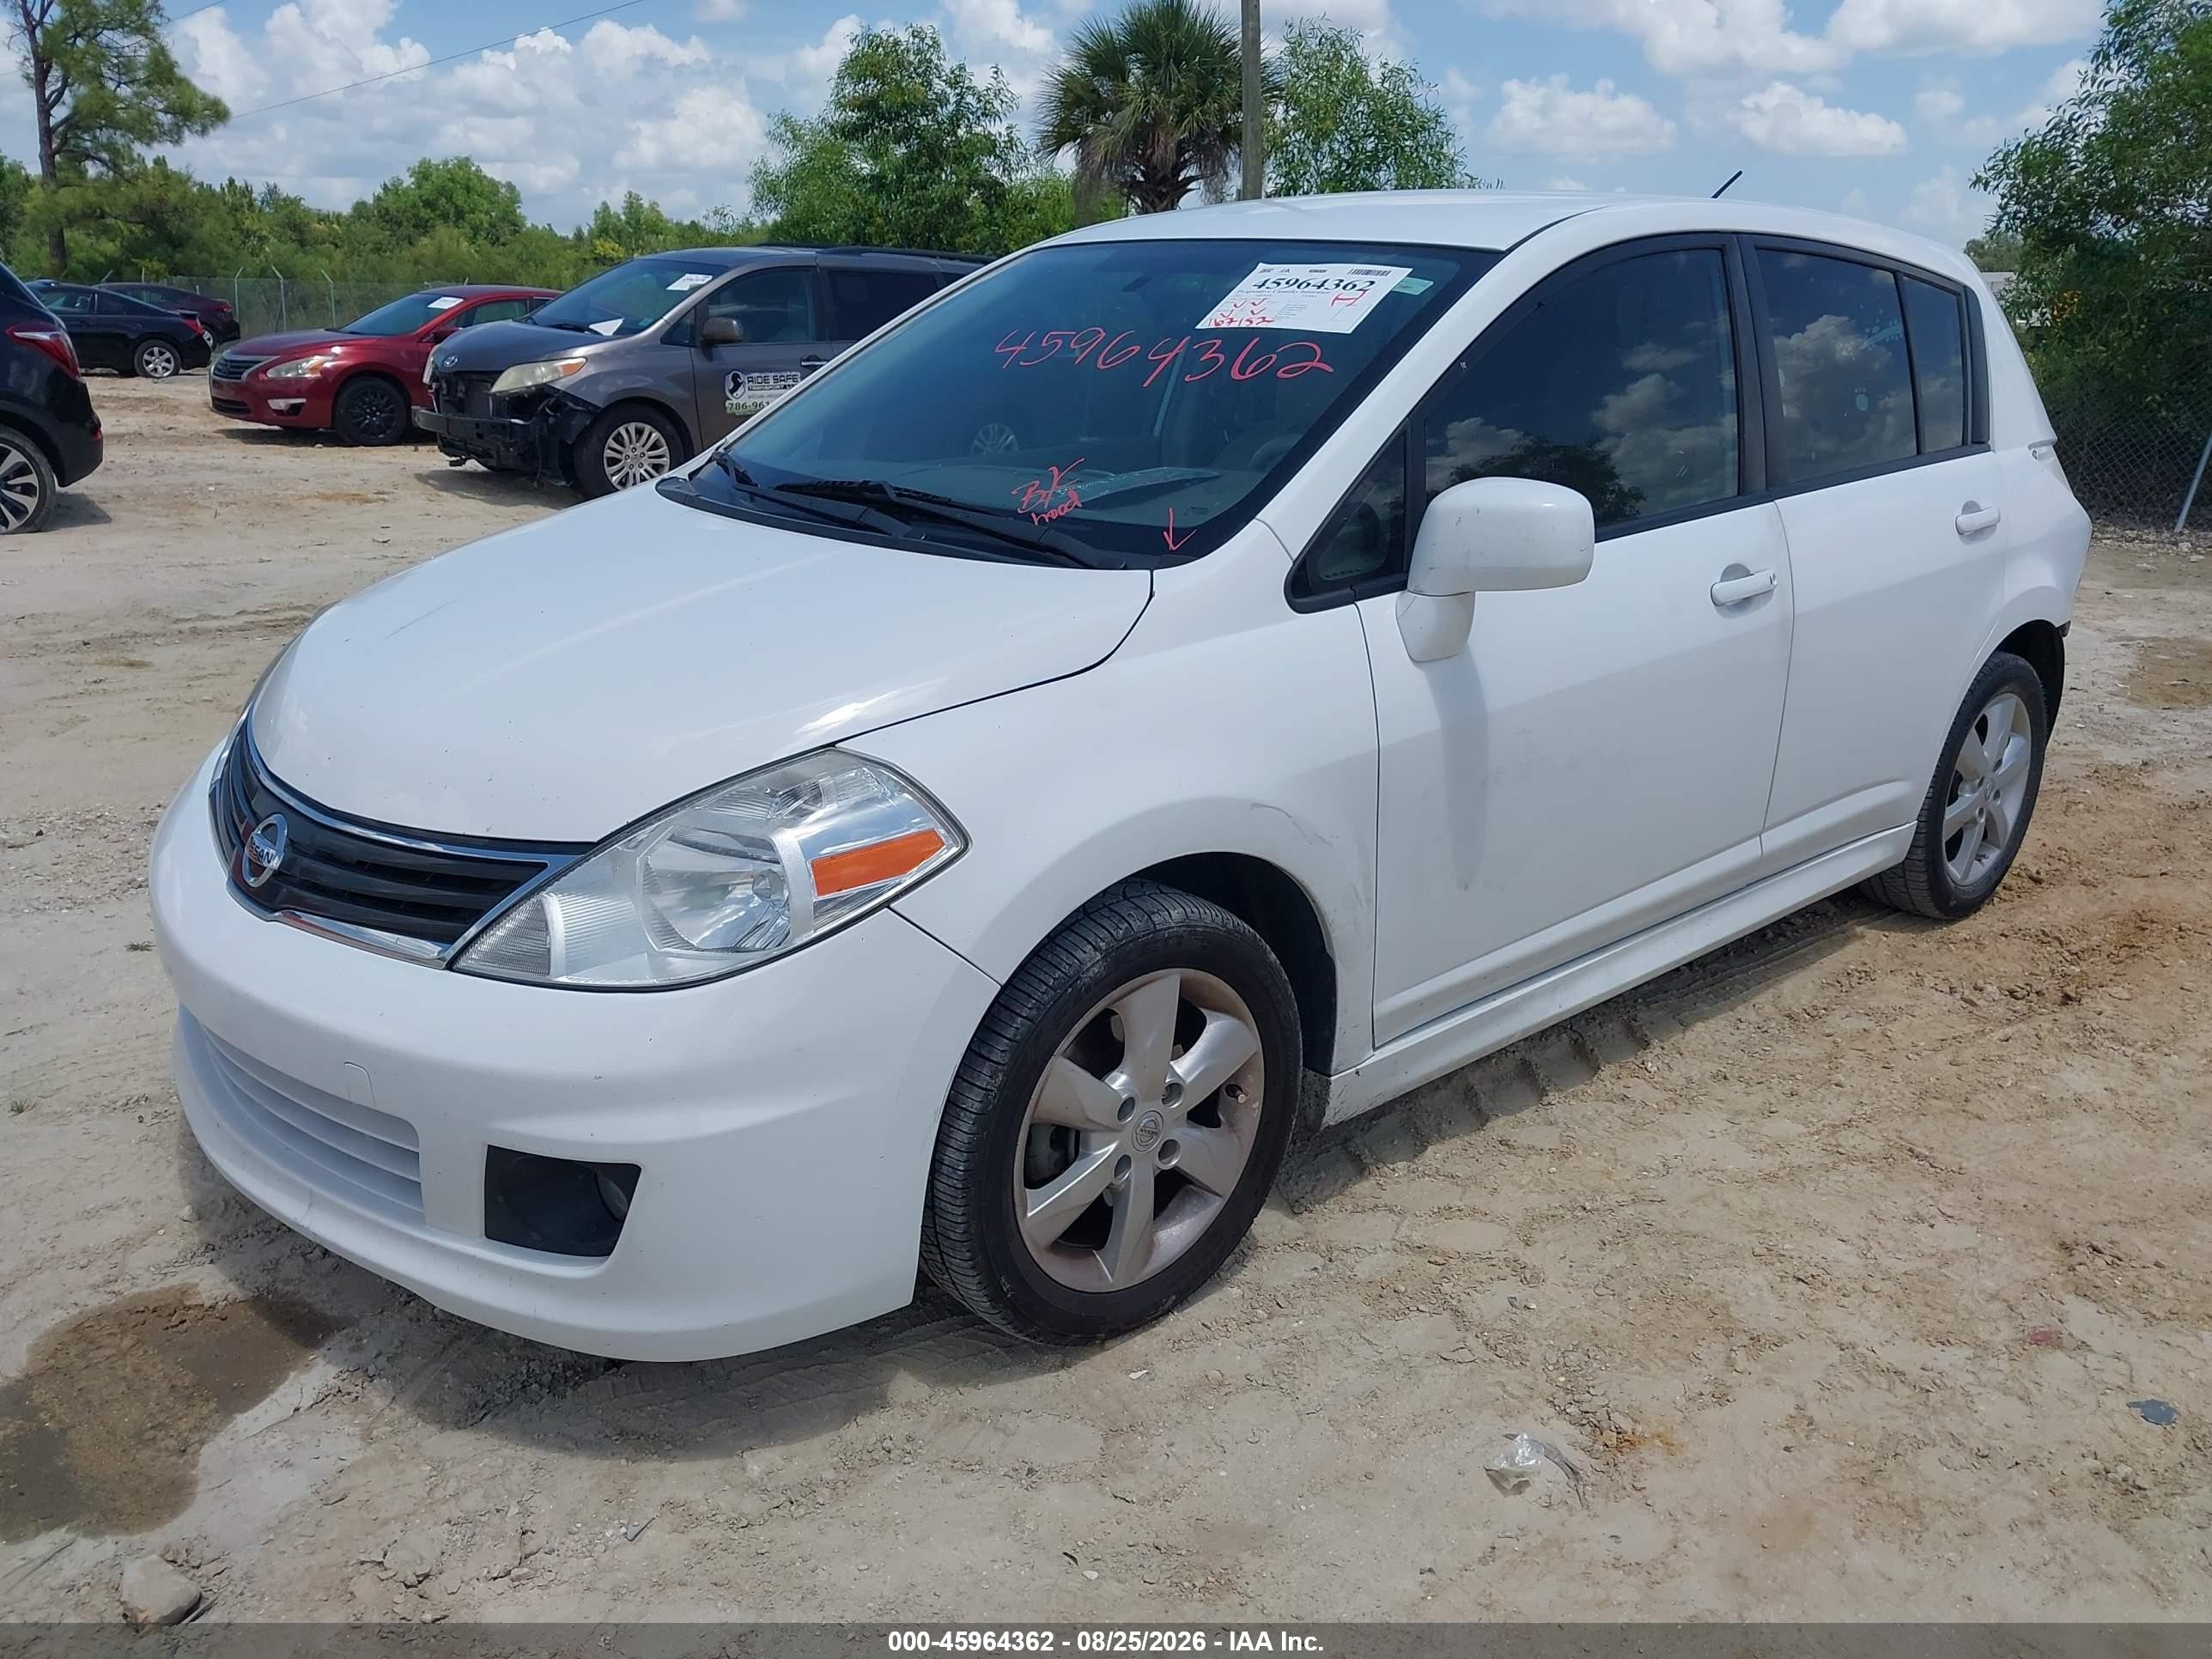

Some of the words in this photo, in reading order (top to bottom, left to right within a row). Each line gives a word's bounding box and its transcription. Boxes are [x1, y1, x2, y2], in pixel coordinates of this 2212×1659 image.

[1253, 277, 1376, 292] 45964362
[994, 326, 1334, 388] 45964362
[747, 375, 770, 385] RIDE
[773, 374, 799, 383] SAFE
